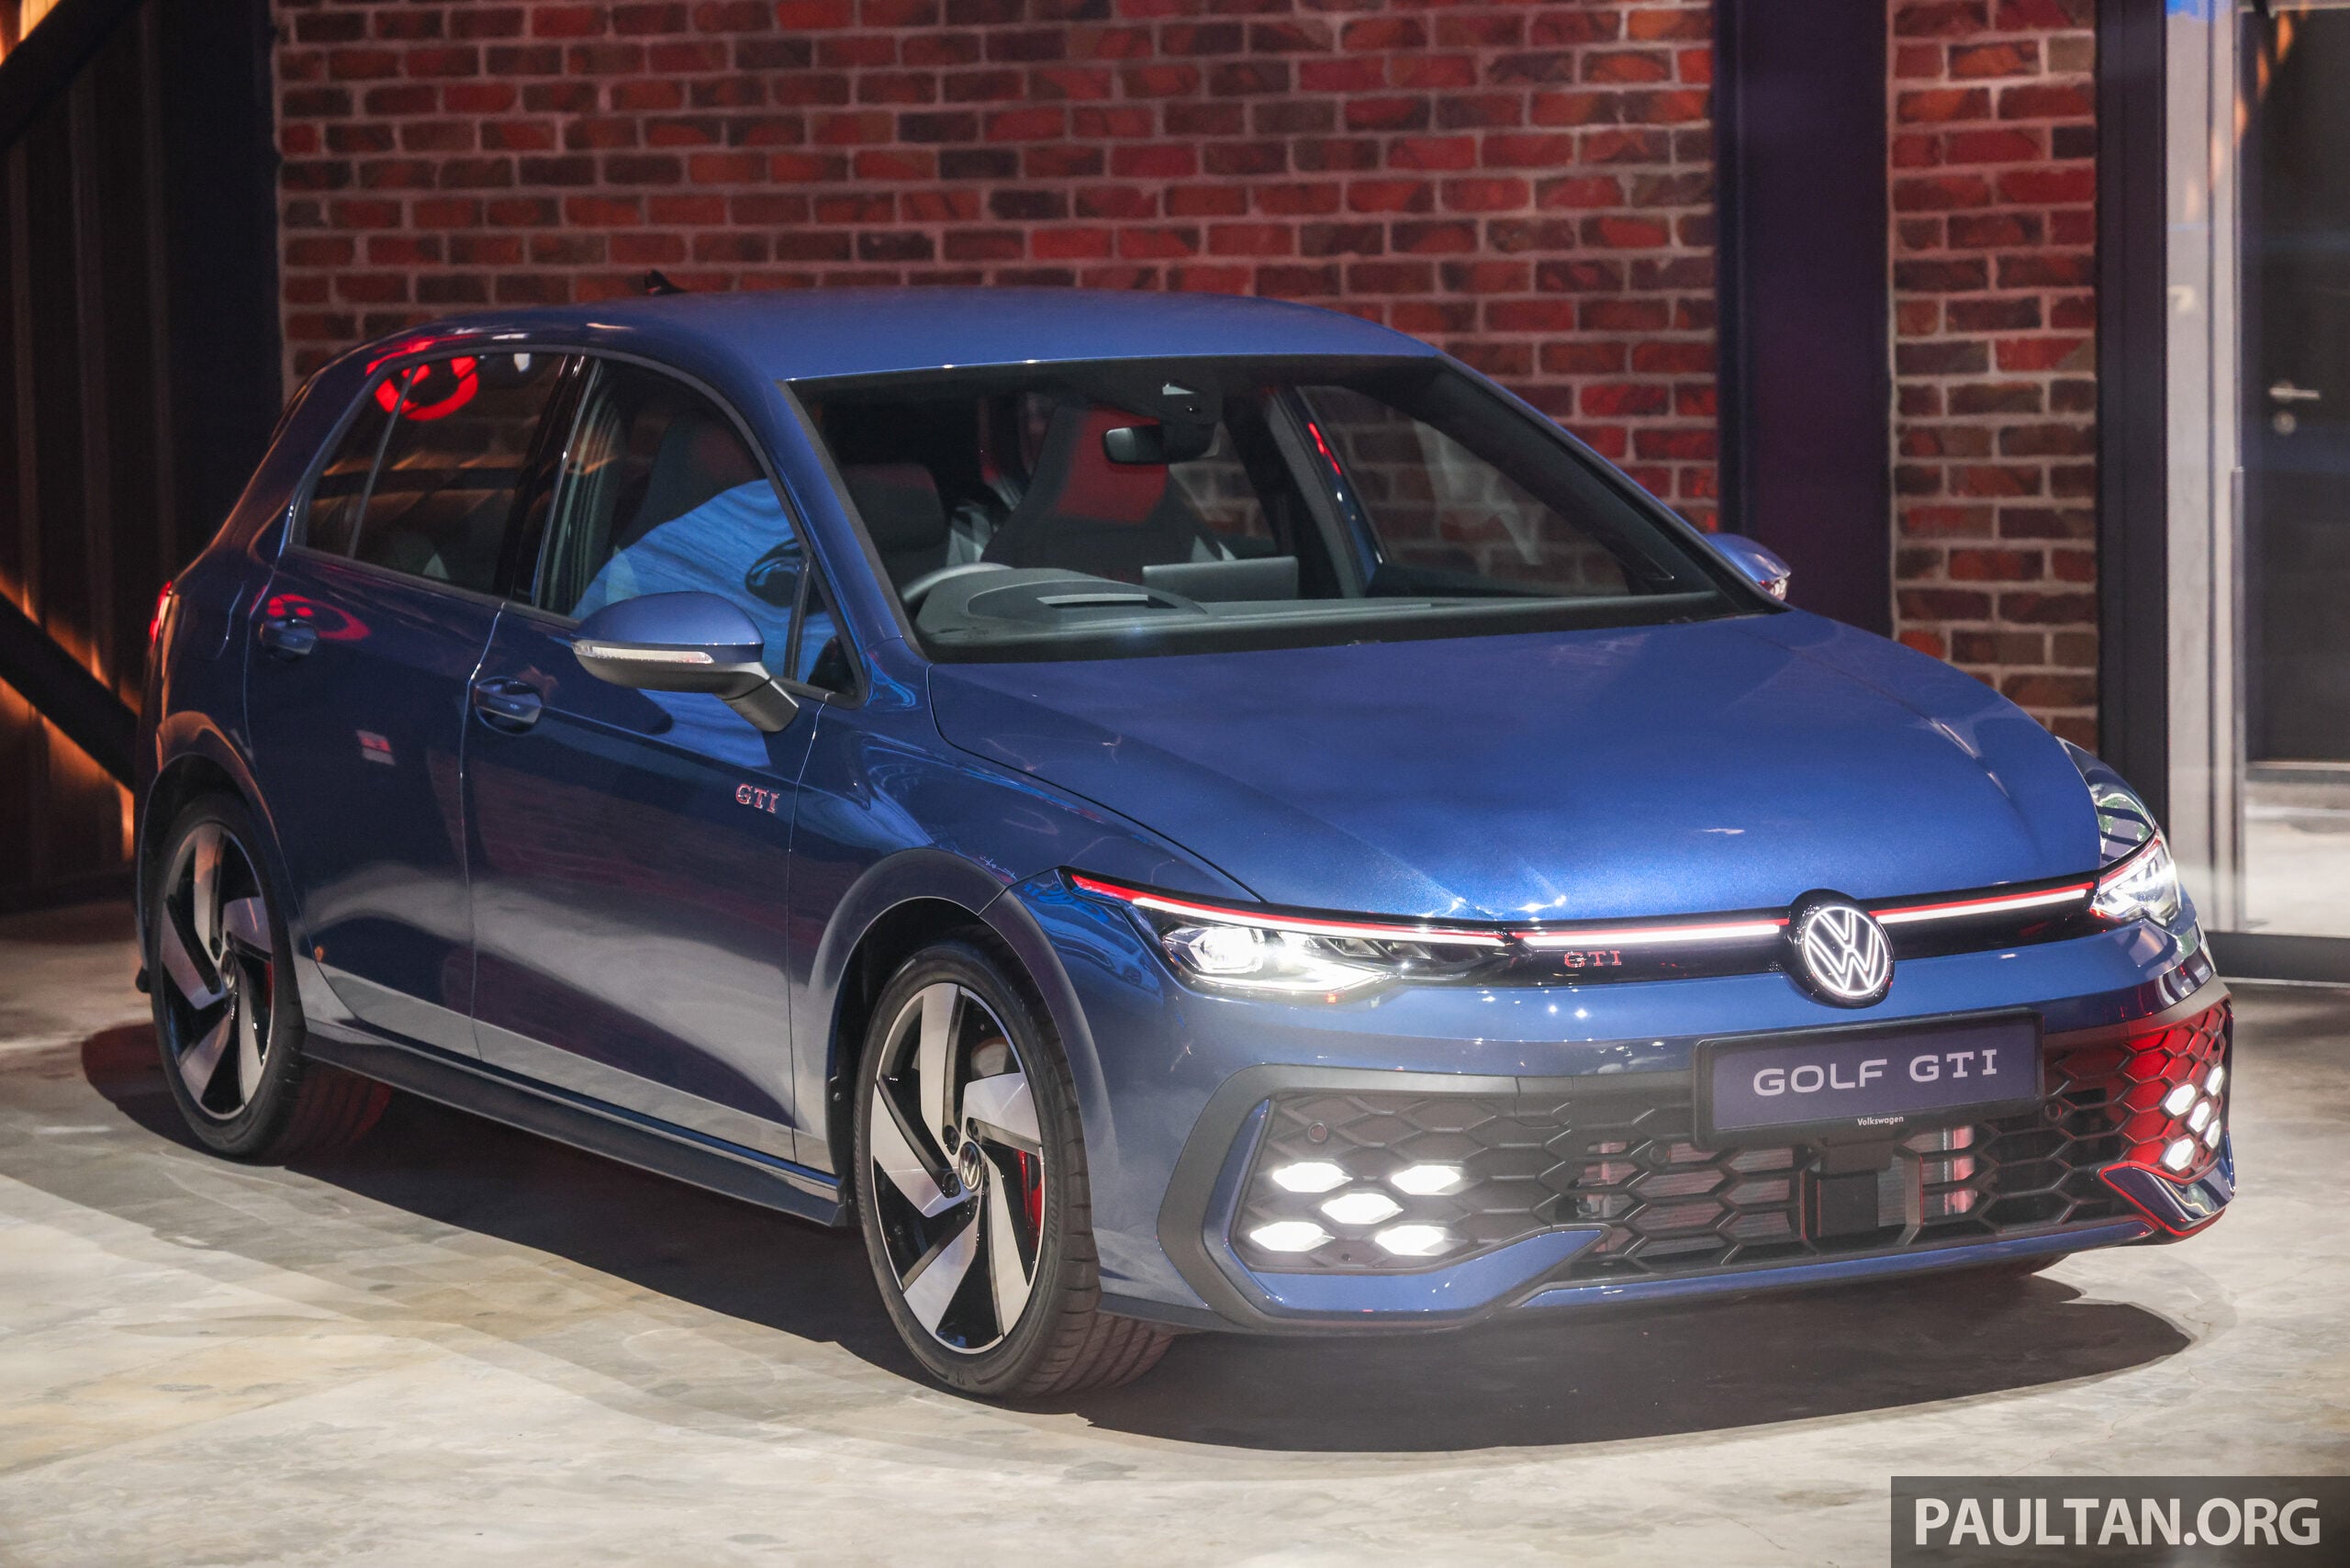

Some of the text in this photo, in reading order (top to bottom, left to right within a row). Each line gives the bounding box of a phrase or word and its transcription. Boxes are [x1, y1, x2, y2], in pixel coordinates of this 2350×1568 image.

[734, 783, 779, 813] GTI
[1563, 950, 1622, 968] GTI
[1805, 906, 1888, 996] VW
[1753, 1048, 1998, 1096] GOLF GTI
[1857, 1114, 1905, 1127] Volkswagen
